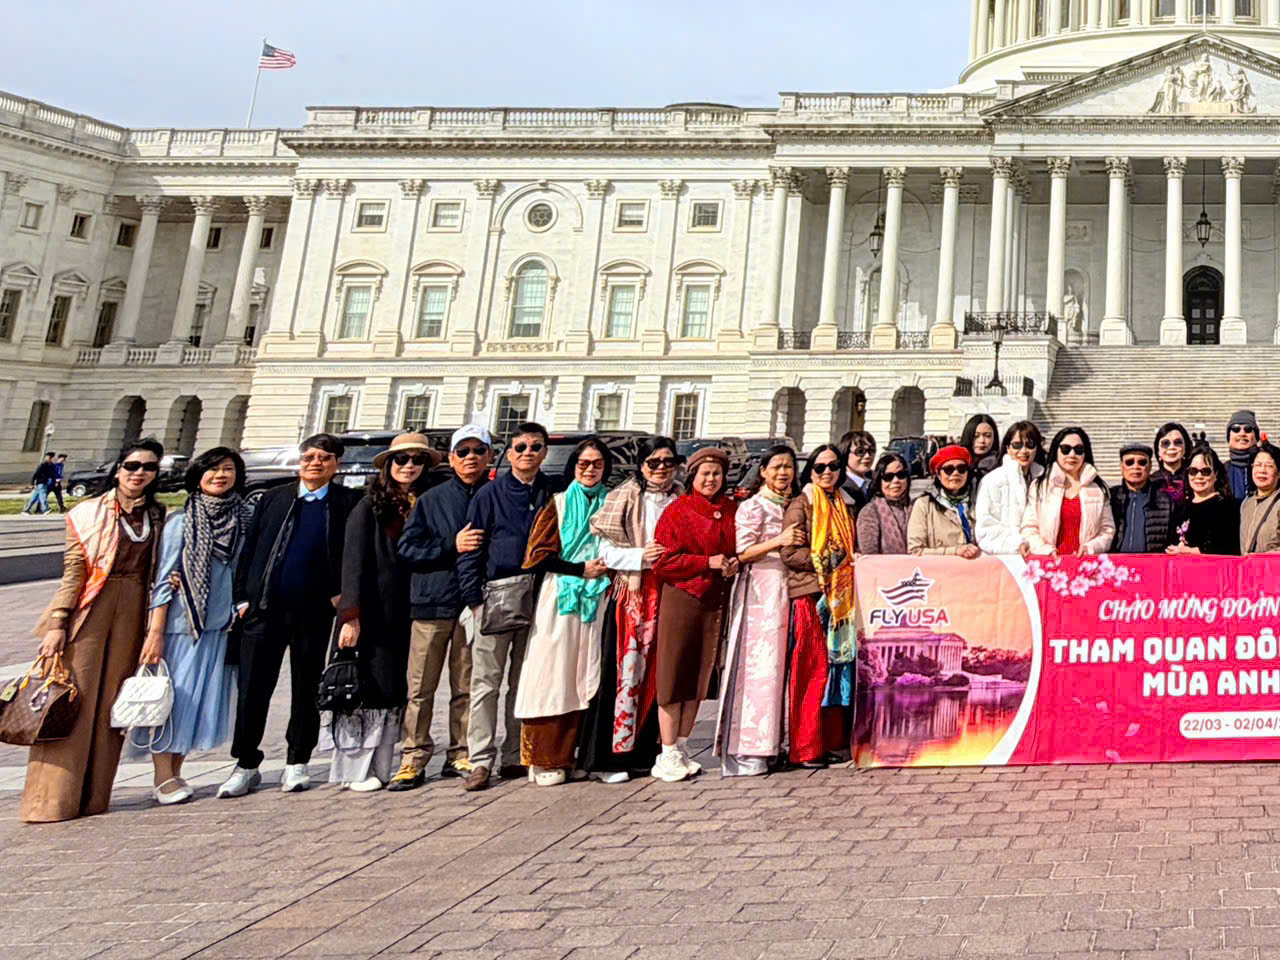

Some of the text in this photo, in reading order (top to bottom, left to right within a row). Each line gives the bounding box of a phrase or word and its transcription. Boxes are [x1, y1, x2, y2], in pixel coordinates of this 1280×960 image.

[908, 608, 949, 624] USA
[1099, 592, 1155, 623] CHÀO
[1157, 592, 1218, 623] MỪNG
[1049, 637, 1135, 664] THAM
[1143, 635, 1227, 664] QUAN
[1142, 664, 1209, 697] MÙA
[1217, 669, 1280, 695] ANH
[1183, 719, 1222, 732] 22/03
